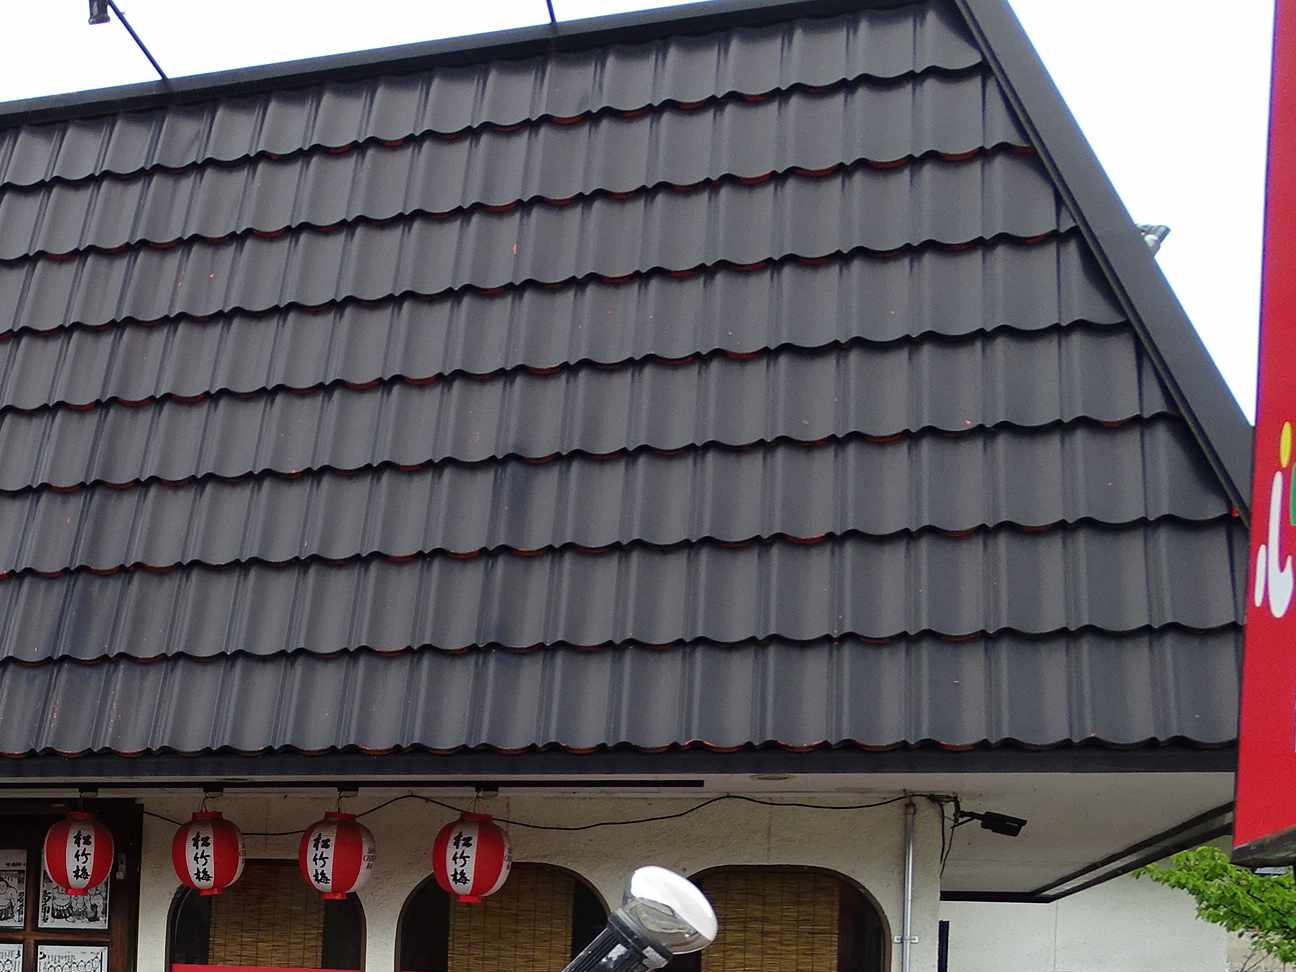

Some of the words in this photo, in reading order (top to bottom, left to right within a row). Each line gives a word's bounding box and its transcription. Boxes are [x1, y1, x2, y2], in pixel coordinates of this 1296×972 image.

[72, 830, 92, 881] 松竹梅
[192, 832, 213, 883] 松竹梅
[312, 833, 331, 885] 松竹梅
[451, 832, 473, 885] 松竹梅
